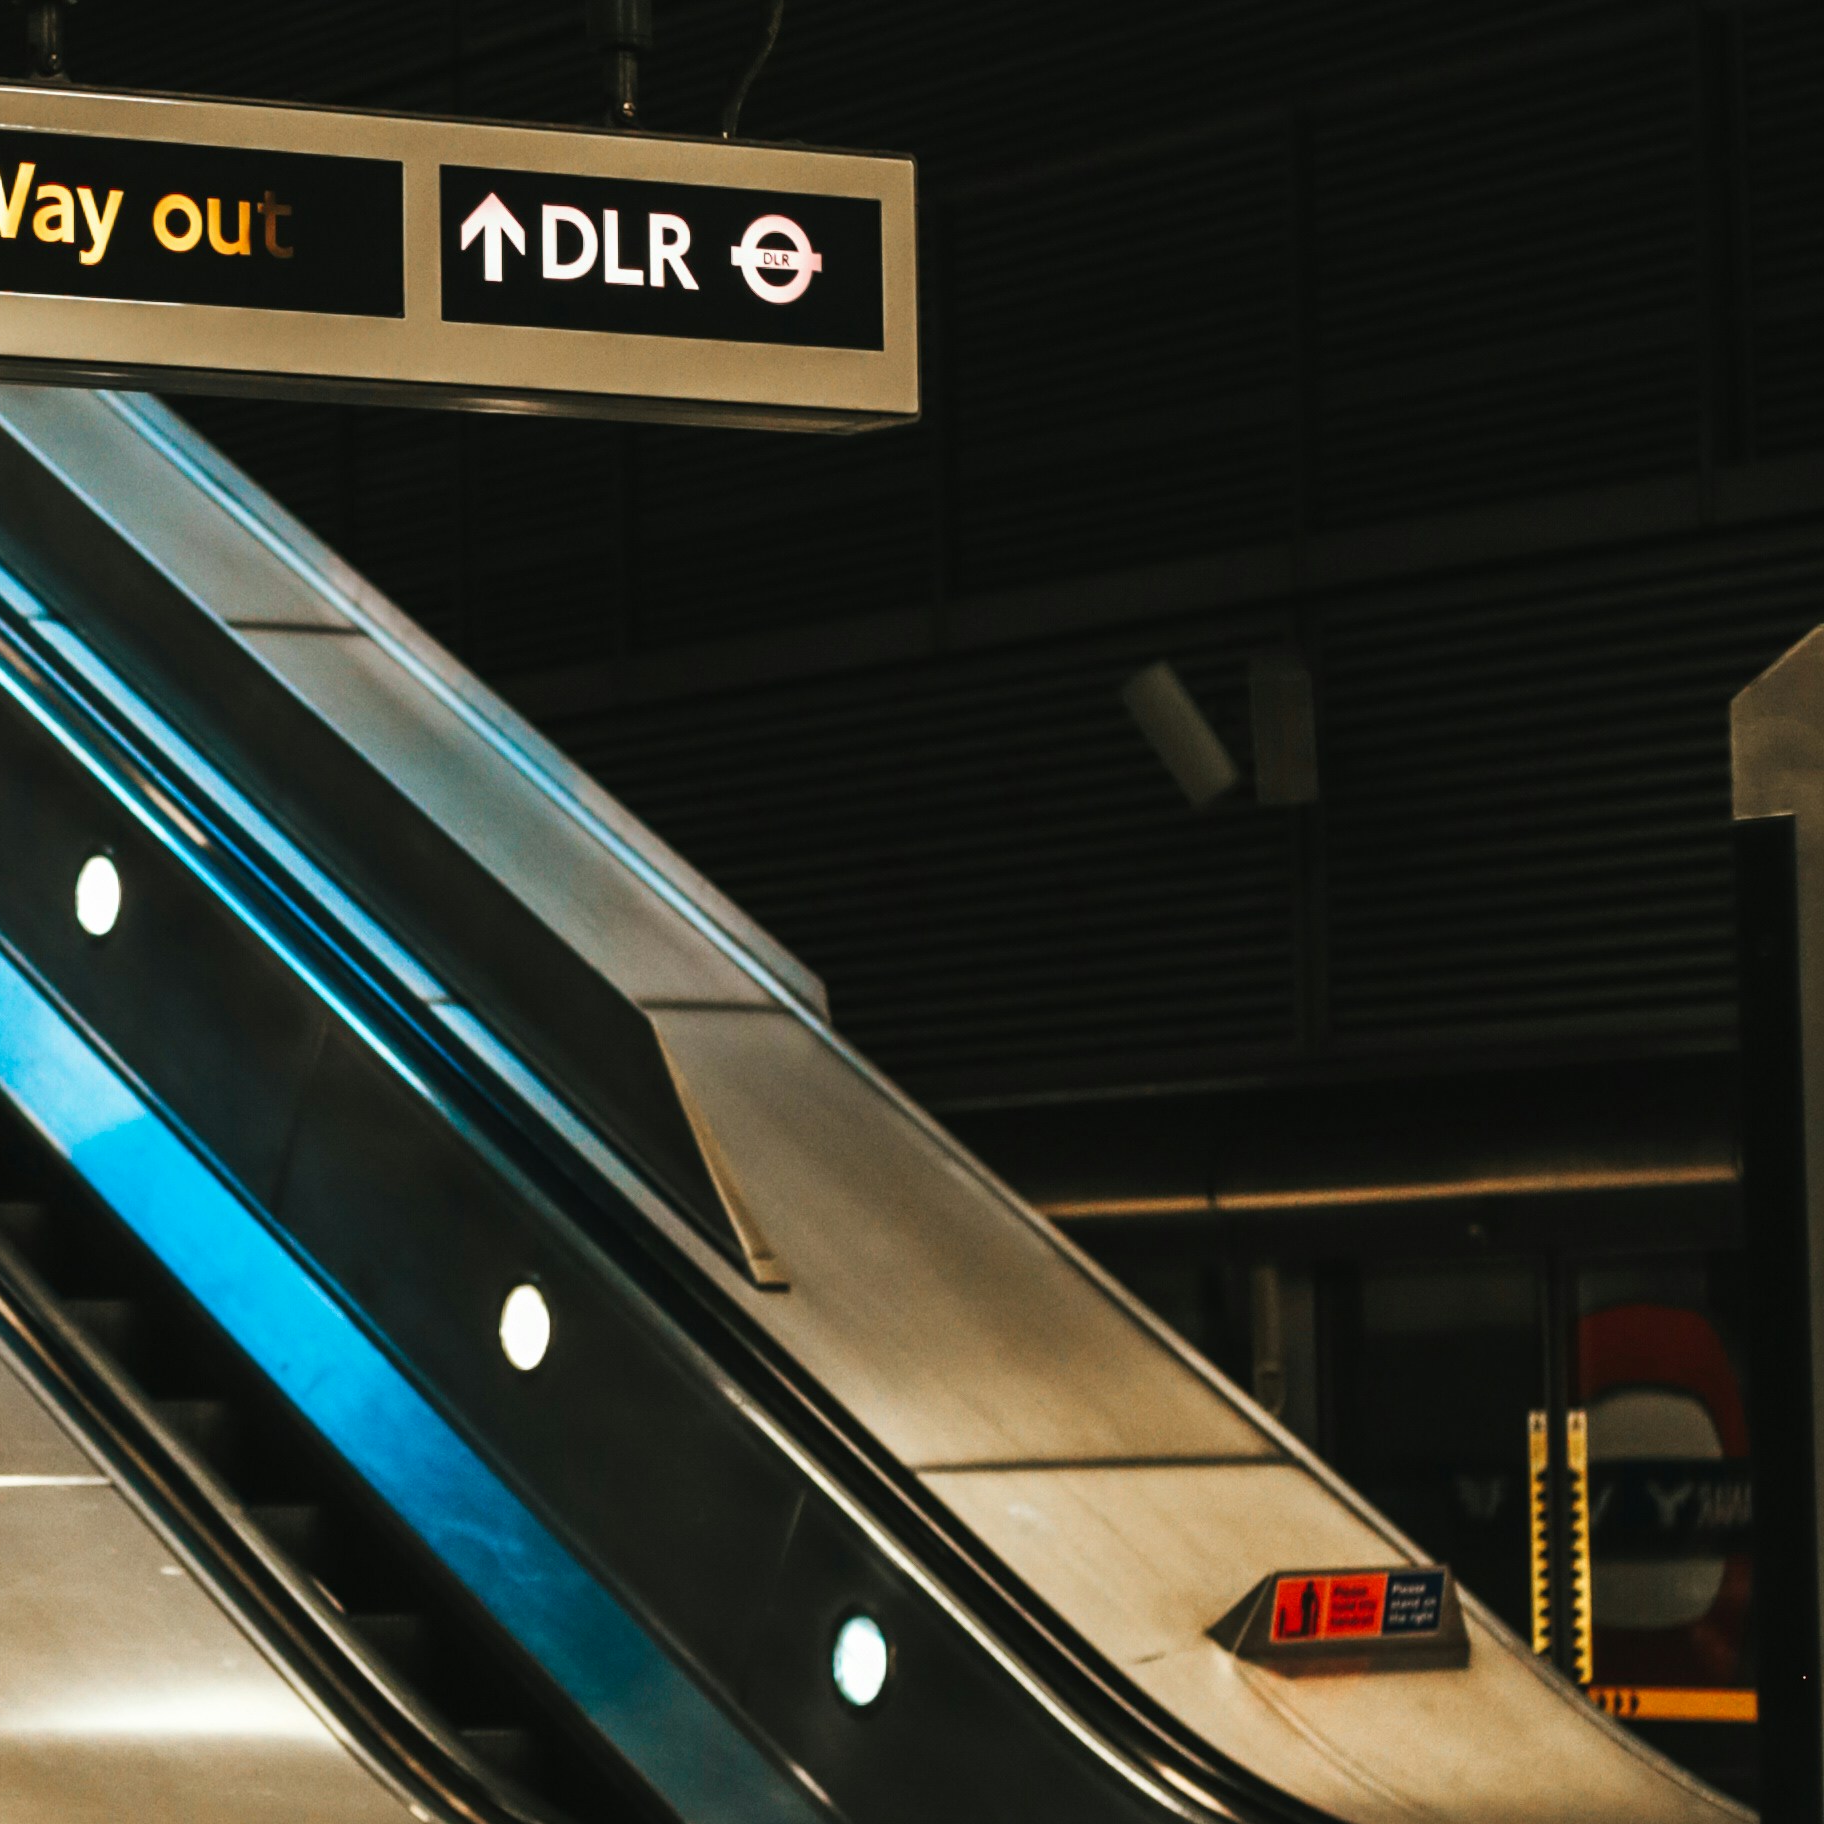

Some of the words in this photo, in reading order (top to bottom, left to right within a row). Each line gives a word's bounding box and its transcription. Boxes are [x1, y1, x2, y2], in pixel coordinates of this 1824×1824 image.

[153, 190, 294, 259] out
[542, 204, 700, 290] DLR
[763, 252, 790, 267] DLR
